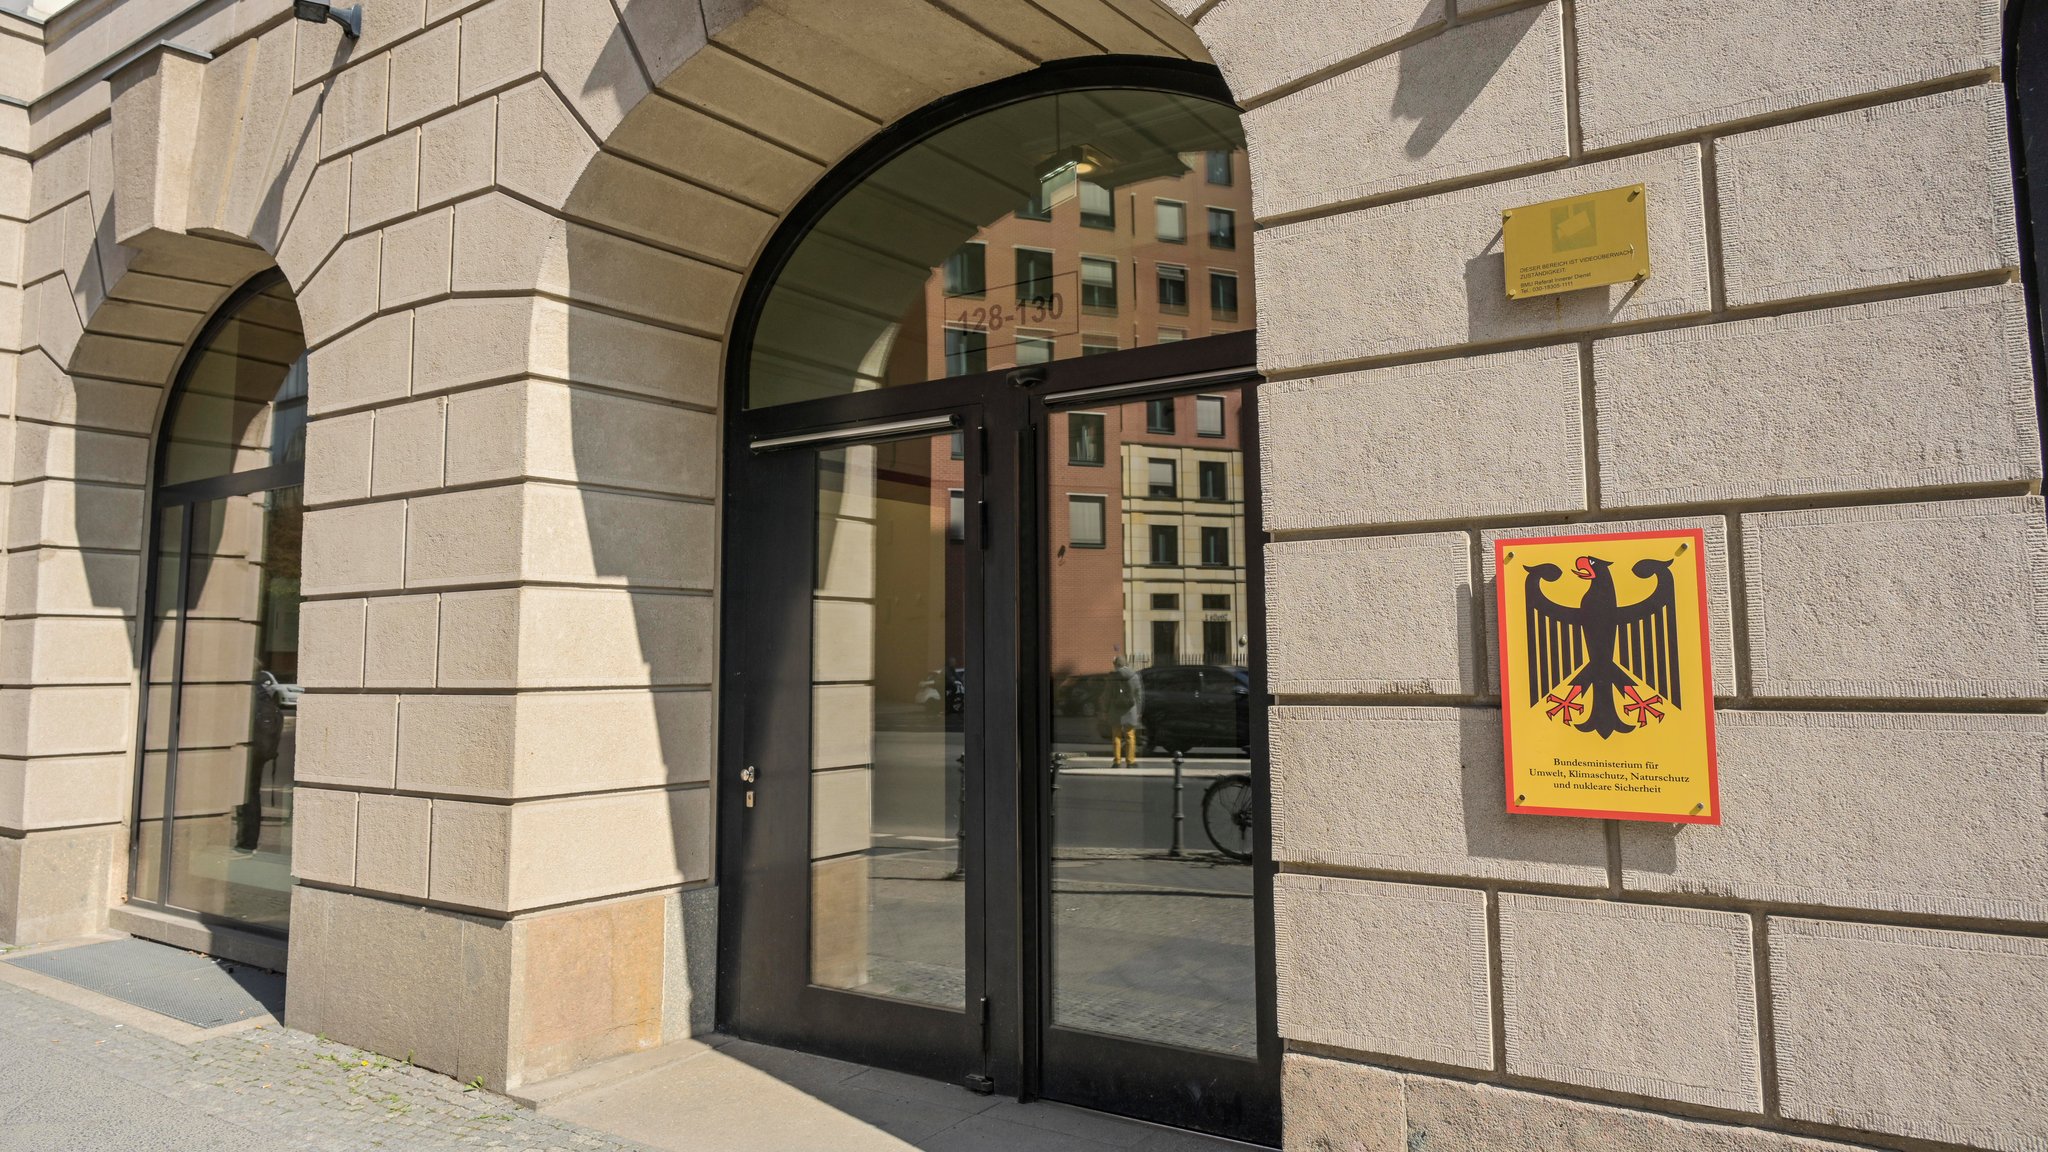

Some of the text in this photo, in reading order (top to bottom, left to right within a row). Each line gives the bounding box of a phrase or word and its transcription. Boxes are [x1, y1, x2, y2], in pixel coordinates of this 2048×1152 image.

[1520, 265, 1541, 273] DIESER
[1541, 261, 1568, 270] BEREICH
[1534, 278, 1554, 286] Referat
[1555, 275, 1573, 283] Innerer
[1574, 272, 1591, 280] Dienst
[958, 293, 1064, 336] 128-130
[1554, 758, 1659, 770] Bundesministerium für
[1529, 768, 1690, 783] Umwelt, Klimaschutz, Naturschutz
[1554, 781, 1661, 793] und nukleare Sicherheit
